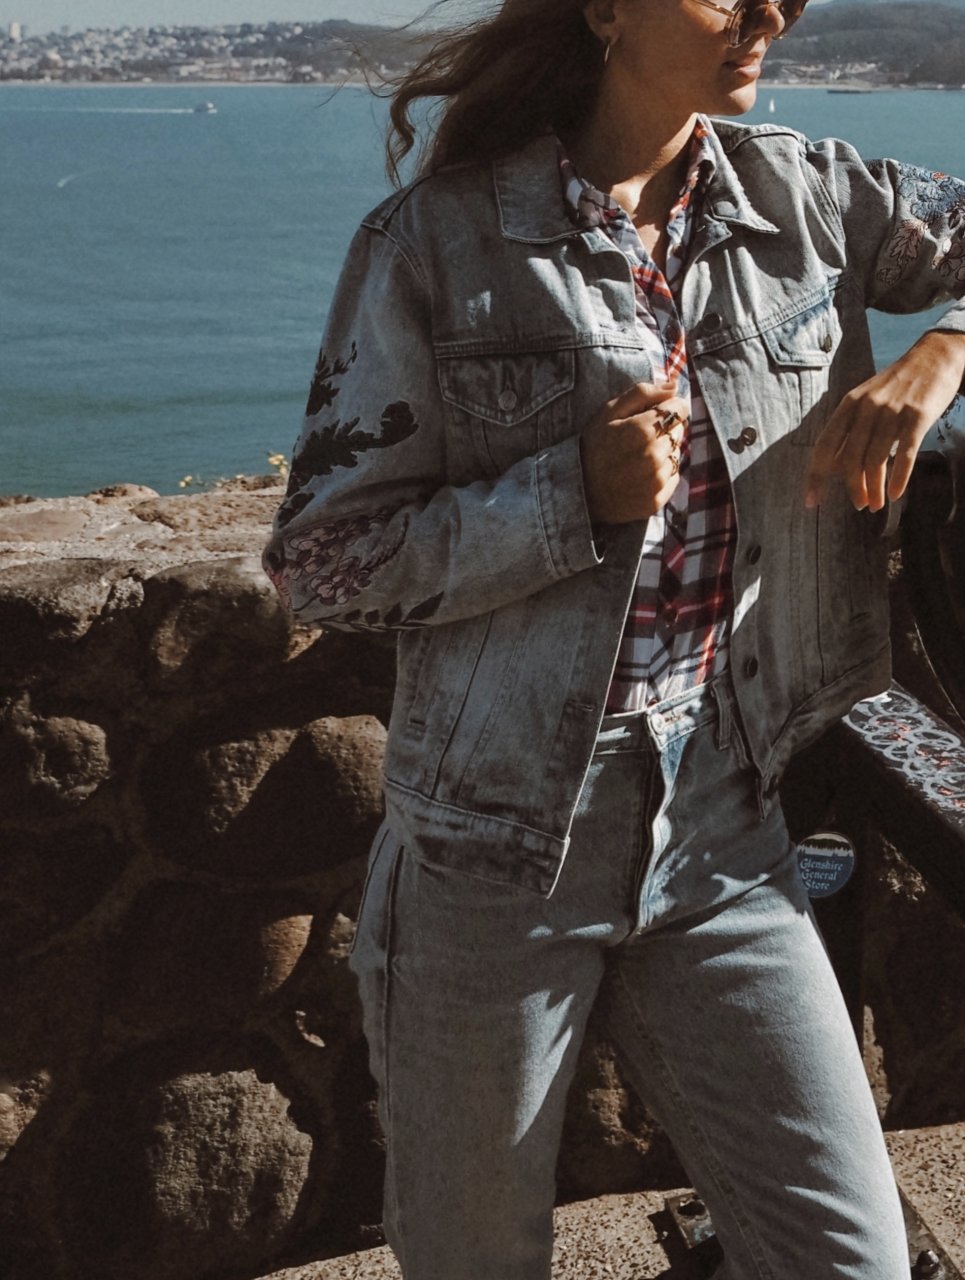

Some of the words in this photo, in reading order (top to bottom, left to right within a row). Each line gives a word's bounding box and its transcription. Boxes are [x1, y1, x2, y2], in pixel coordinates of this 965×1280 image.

[799, 858, 844, 871] Glenshire
[801, 869, 838, 880] General
[804, 879, 831, 890] Store
